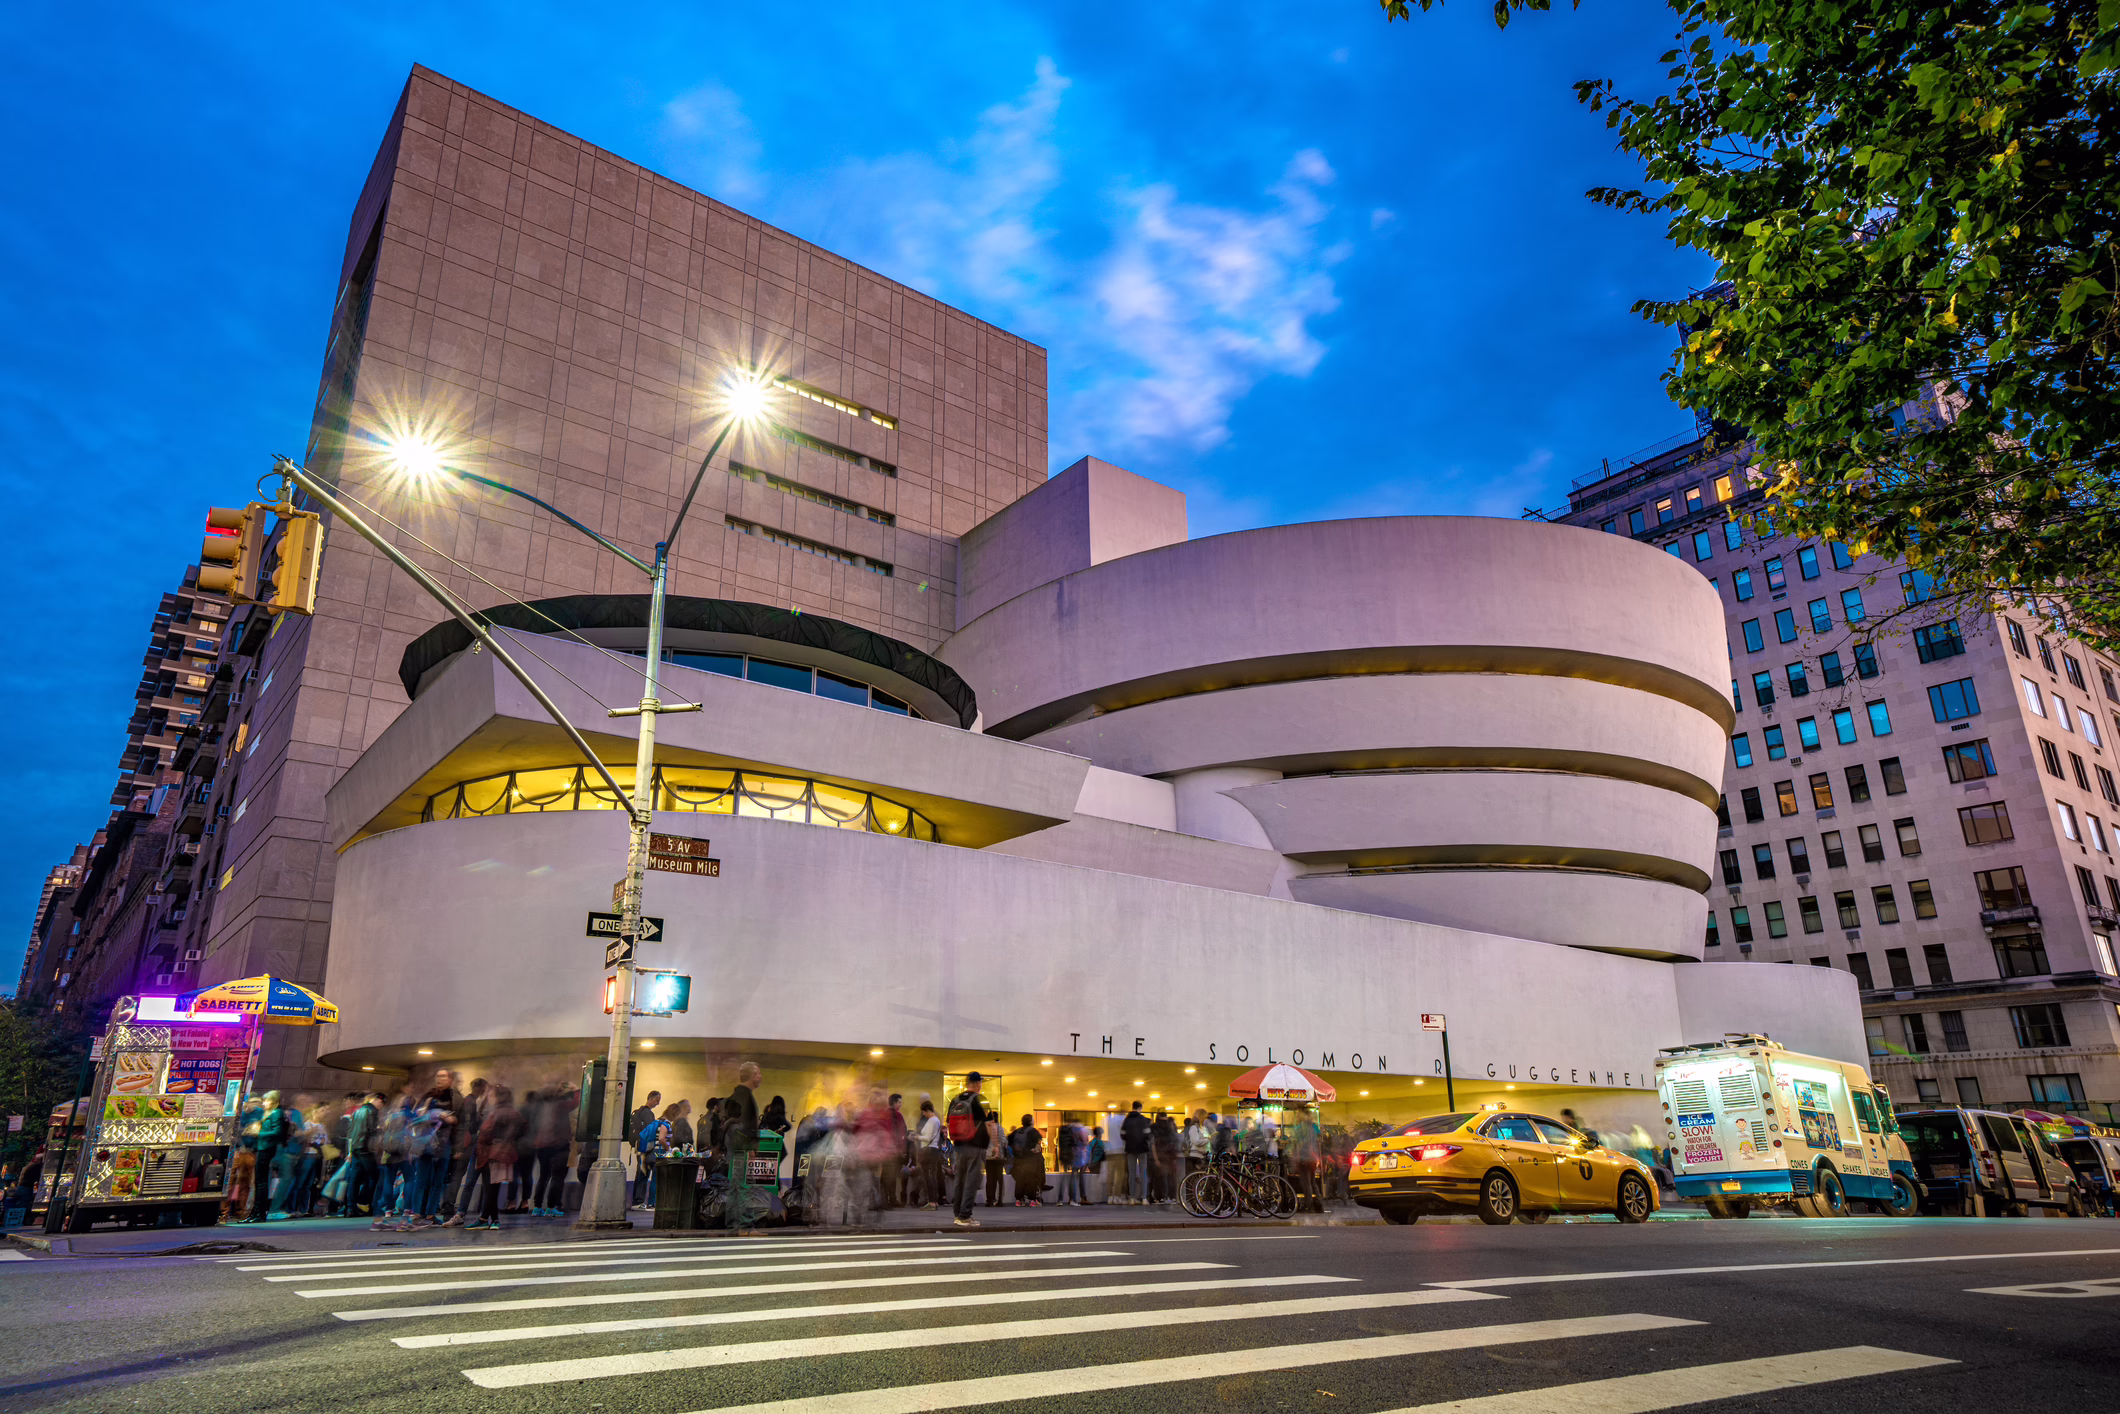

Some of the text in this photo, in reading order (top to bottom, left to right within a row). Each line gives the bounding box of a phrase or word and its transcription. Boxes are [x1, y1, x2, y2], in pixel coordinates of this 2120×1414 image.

[667, 838, 691, 853] 5 Av
[649, 856, 718, 875] Museum Mile
[598, 920, 652, 934] ONE AY
[199, 1000, 263, 1011] SABRETT
[171, 1060, 180, 1070] 2
[1070, 1033, 1145, 1056] THE
[1209, 1043, 1387, 1071] SOLOMON
[1434, 1059, 1442, 1075] R
[1487, 1063, 1657, 1088] GUGGENHEI
[169, 1071, 219, 1079] FREE DRINK
[1680, 1118, 1714, 1126] CREAM
[1681, 1125, 1714, 1138] SLOW!
[1686, 1136, 1703, 1144] WATCH
[1685, 1142, 1717, 1152] OUR CHILDREN
[1687, 1149, 1720, 1157] FROZEN
[1688, 1155, 1722, 1163] YOGURT
[1790, 1159, 1808, 1169] CONES
[1581, 1162, 1591, 1178] T
[1842, 1164, 1862, 1174] SHAKES
